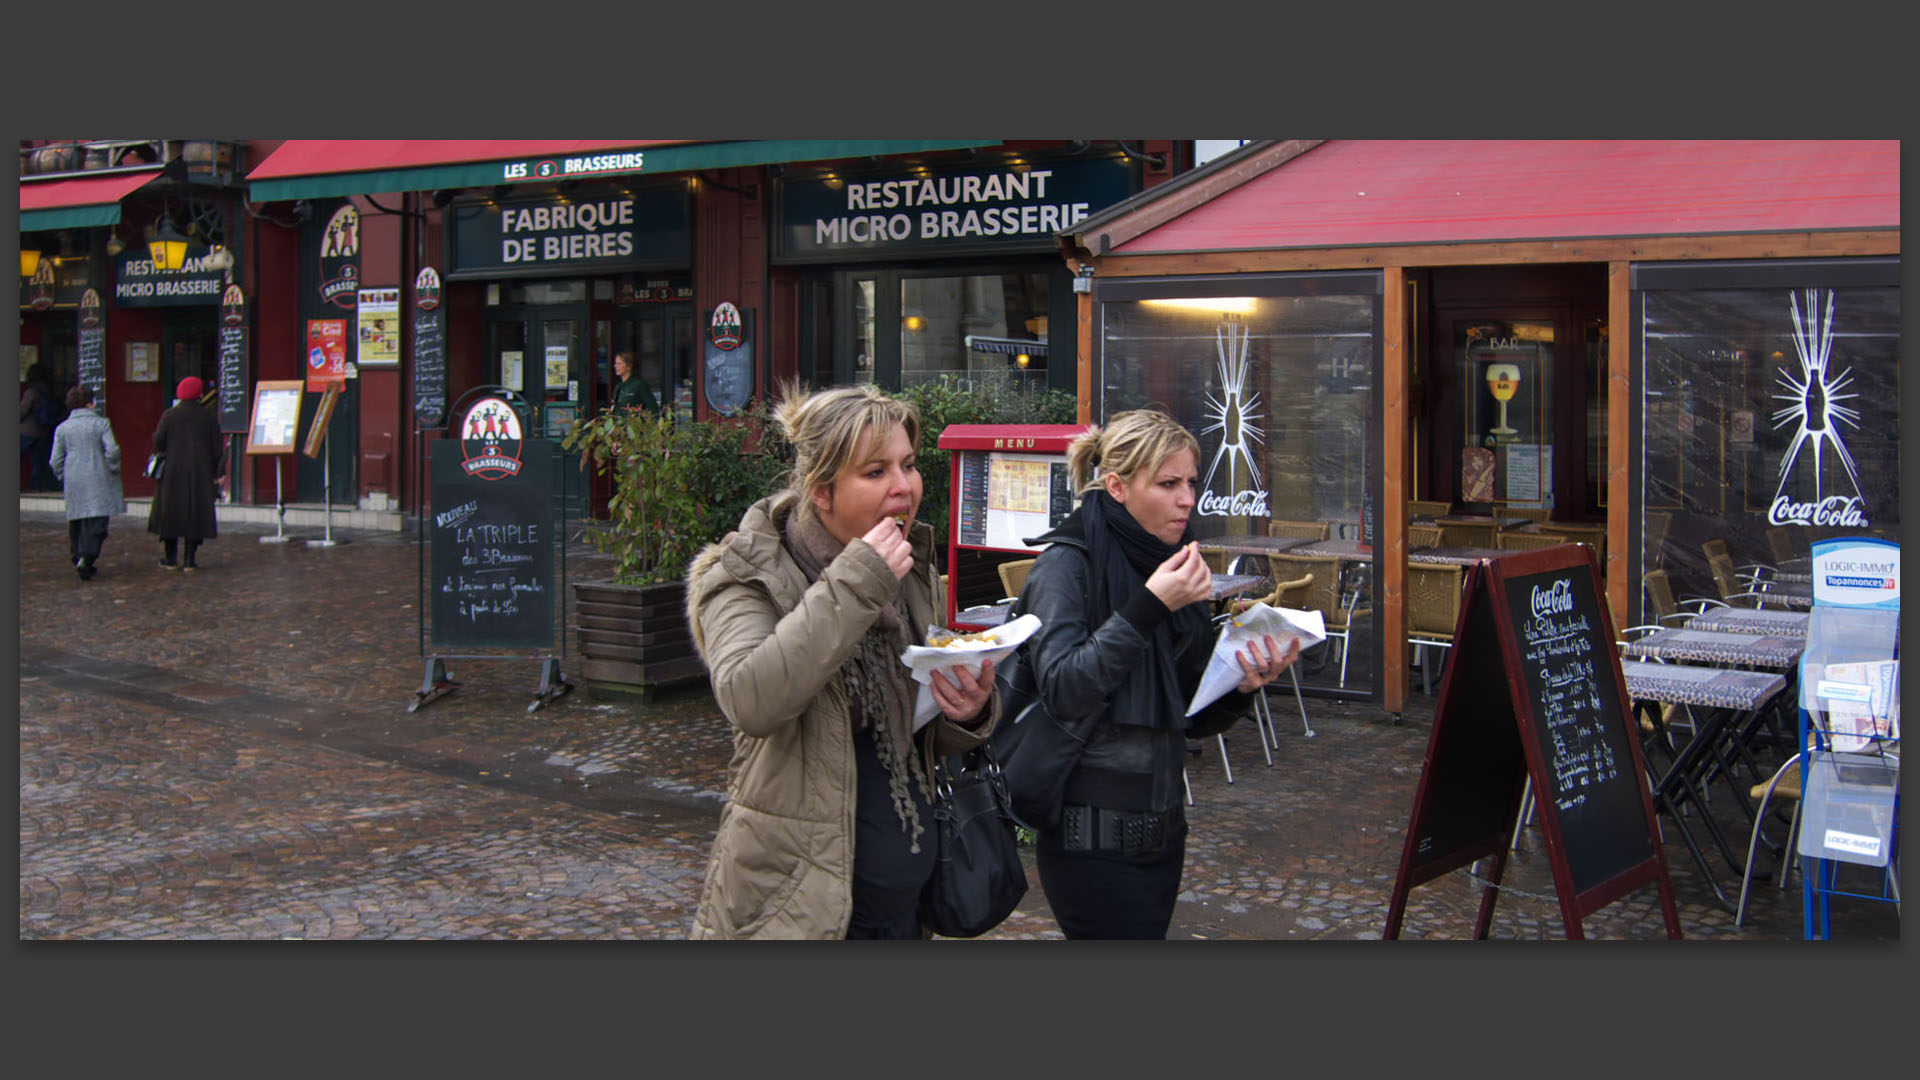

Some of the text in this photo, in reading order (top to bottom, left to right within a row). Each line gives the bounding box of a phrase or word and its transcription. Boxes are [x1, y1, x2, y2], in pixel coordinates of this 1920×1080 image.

[504, 153, 643, 178] LES 3 BRASSEURS
[847, 170, 1052, 210] RESTAURANT
[502, 200, 634, 234] FABRIQUE
[816, 203, 1089, 245] MICRO BRASSERIE
[502, 232, 633, 263] DE BIERES
[126, 256, 209, 276] RESTAN
[116, 279, 220, 298] MICRO BRASSERIE
[325, 280, 358, 297] BRASSE
[635, 289, 650, 299] LES
[1490, 337, 1519, 351] BAR
[488, 448, 496, 456] 3
[994, 438, 1035, 448] MENU
[468, 458, 516, 471] BRASSEURS
[437, 499, 477, 528] NOUVEAU
[457, 524, 538, 544] LA TRIPLE
